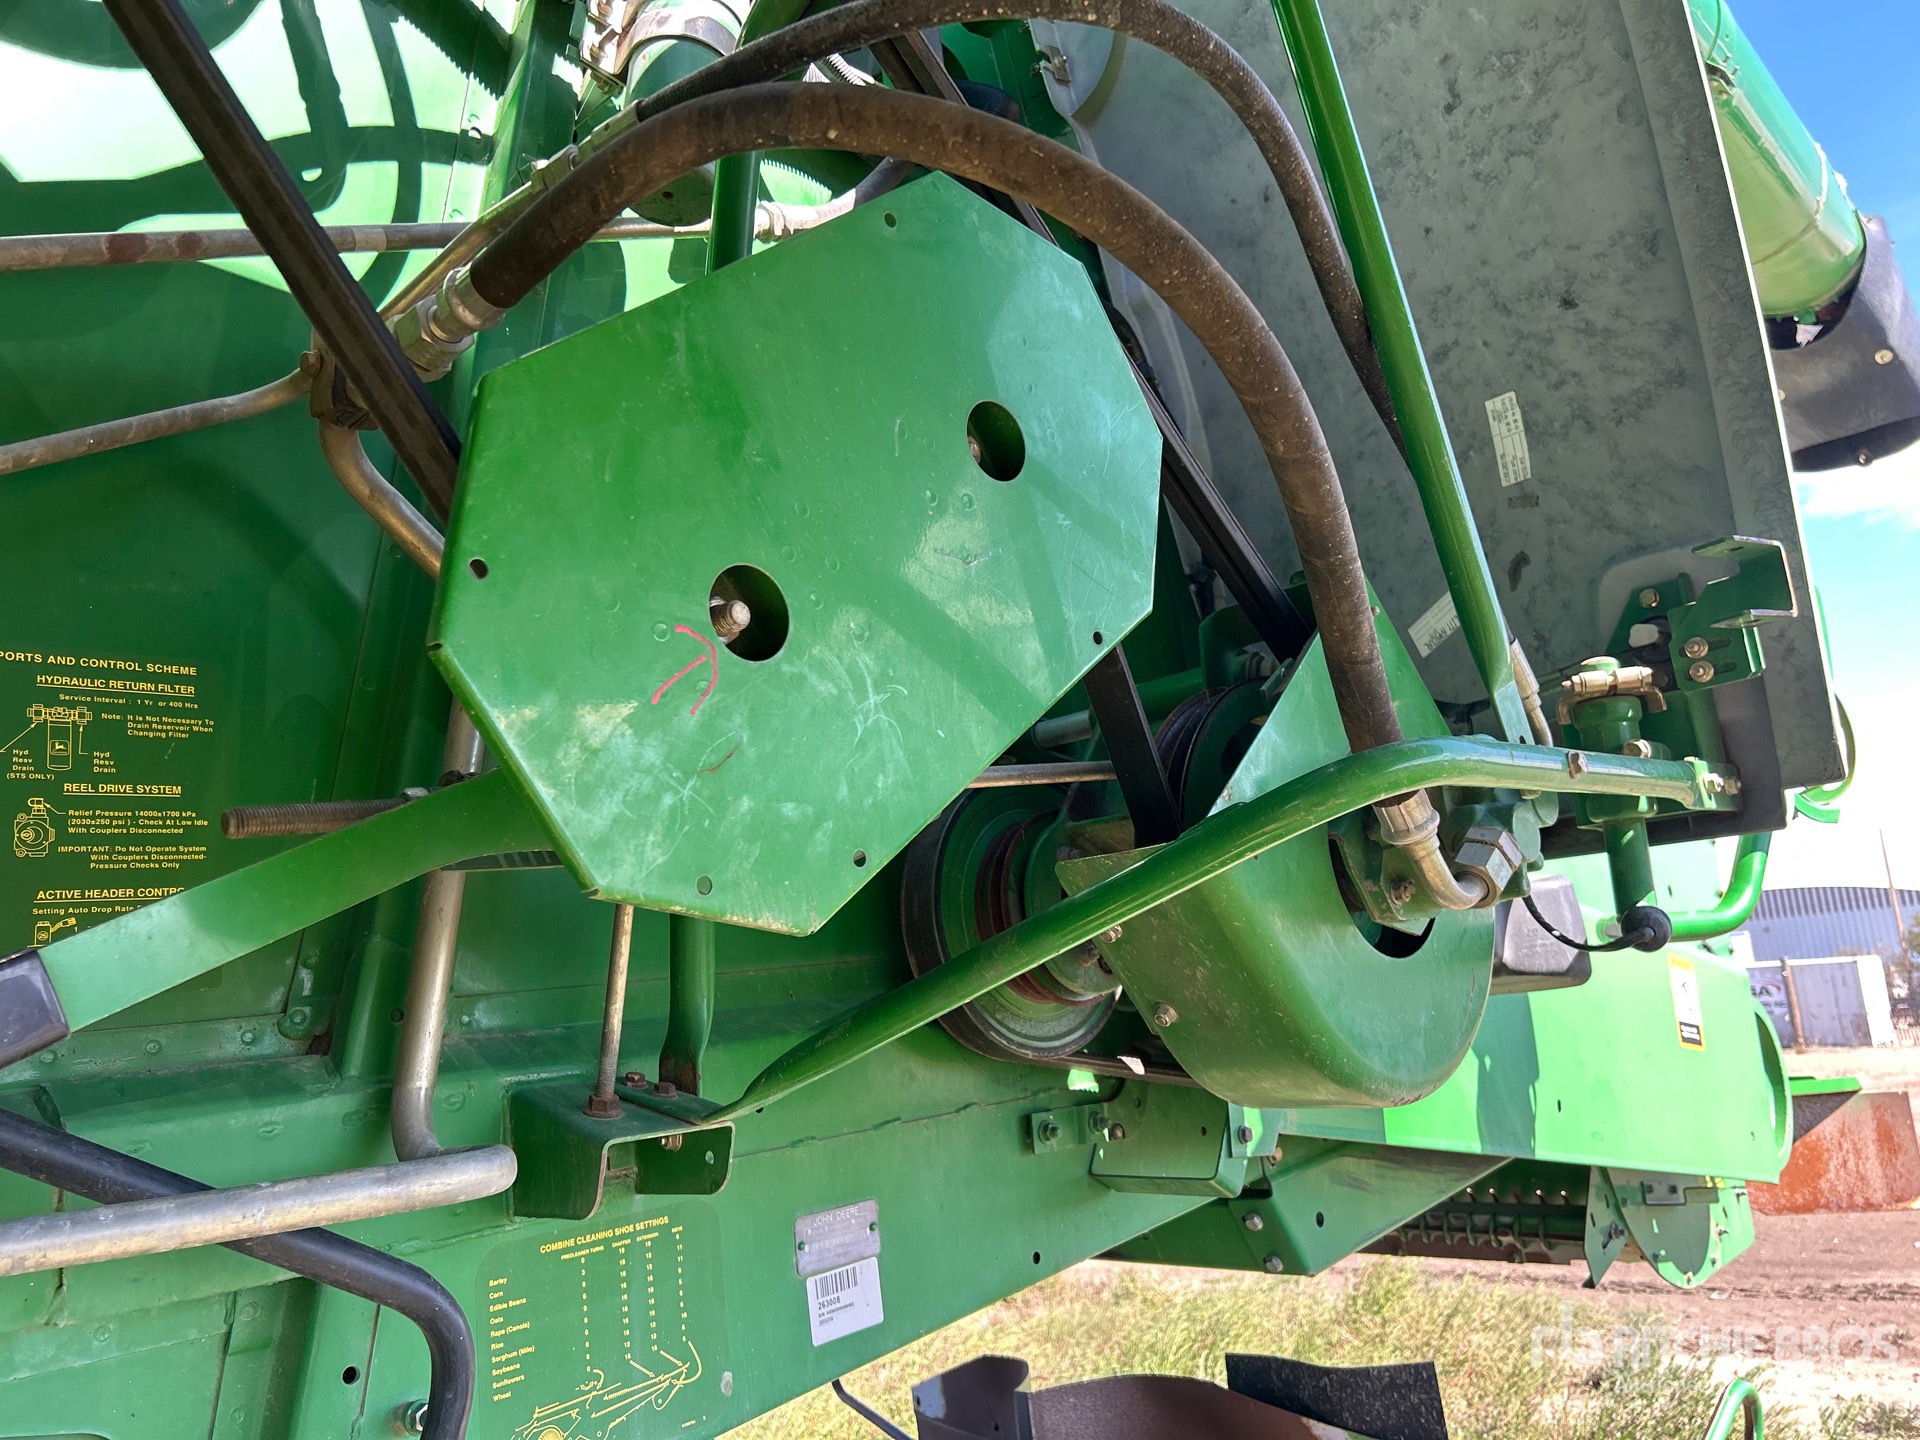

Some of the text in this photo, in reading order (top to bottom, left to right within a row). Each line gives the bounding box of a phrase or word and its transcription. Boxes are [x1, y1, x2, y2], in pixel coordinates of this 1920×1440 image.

[47, 655, 76, 666] AND
[80, 658, 142, 672] CONTROL
[146, 664, 197, 676] SCHEME
[37, 674, 195, 694] HYDRAULIC RETURN FILTER
[59, 694, 91, 702] Service
[94, 696, 126, 704] Interval
[102, 712, 124, 720] Note:
[162, 716, 202, 726] Necessary
[204, 718, 214, 726] To
[152, 723, 190, 732] Reservoir
[127, 730, 166, 739] Changing
[29, 773, 55, 781] ONLY)
[63, 783, 182, 794] REEL DRIVE SYSTEM
[89, 827, 127, 835] Couplers
[146, 846, 176, 854] Operate
[37, 890, 82, 900] ACTIVE
[85, 889, 134, 899] HEADER
[32, 908, 65, 916] Setting
[91, 906, 112, 914] Drop
[813, 1206, 859, 1226] JOHN DEERE
[540, 1216, 669, 1253] COMBINE CLEANING SHOE SETTINGS
[489, 1278, 507, 1286] Barley
[489, 1291, 503, 1299] Corn
[490, 1298, 526, 1312] Edible Beans
[490, 1321, 530, 1337] Rape (Canola)
[491, 1342, 504, 1350] Rice
[492, 1345, 535, 1363] Sorghum (Milo)
[492, 1363, 520, 1376] Soybeans
[493, 1375, 524, 1389] Sunflowers
[493, 1391, 511, 1401] Wheat
